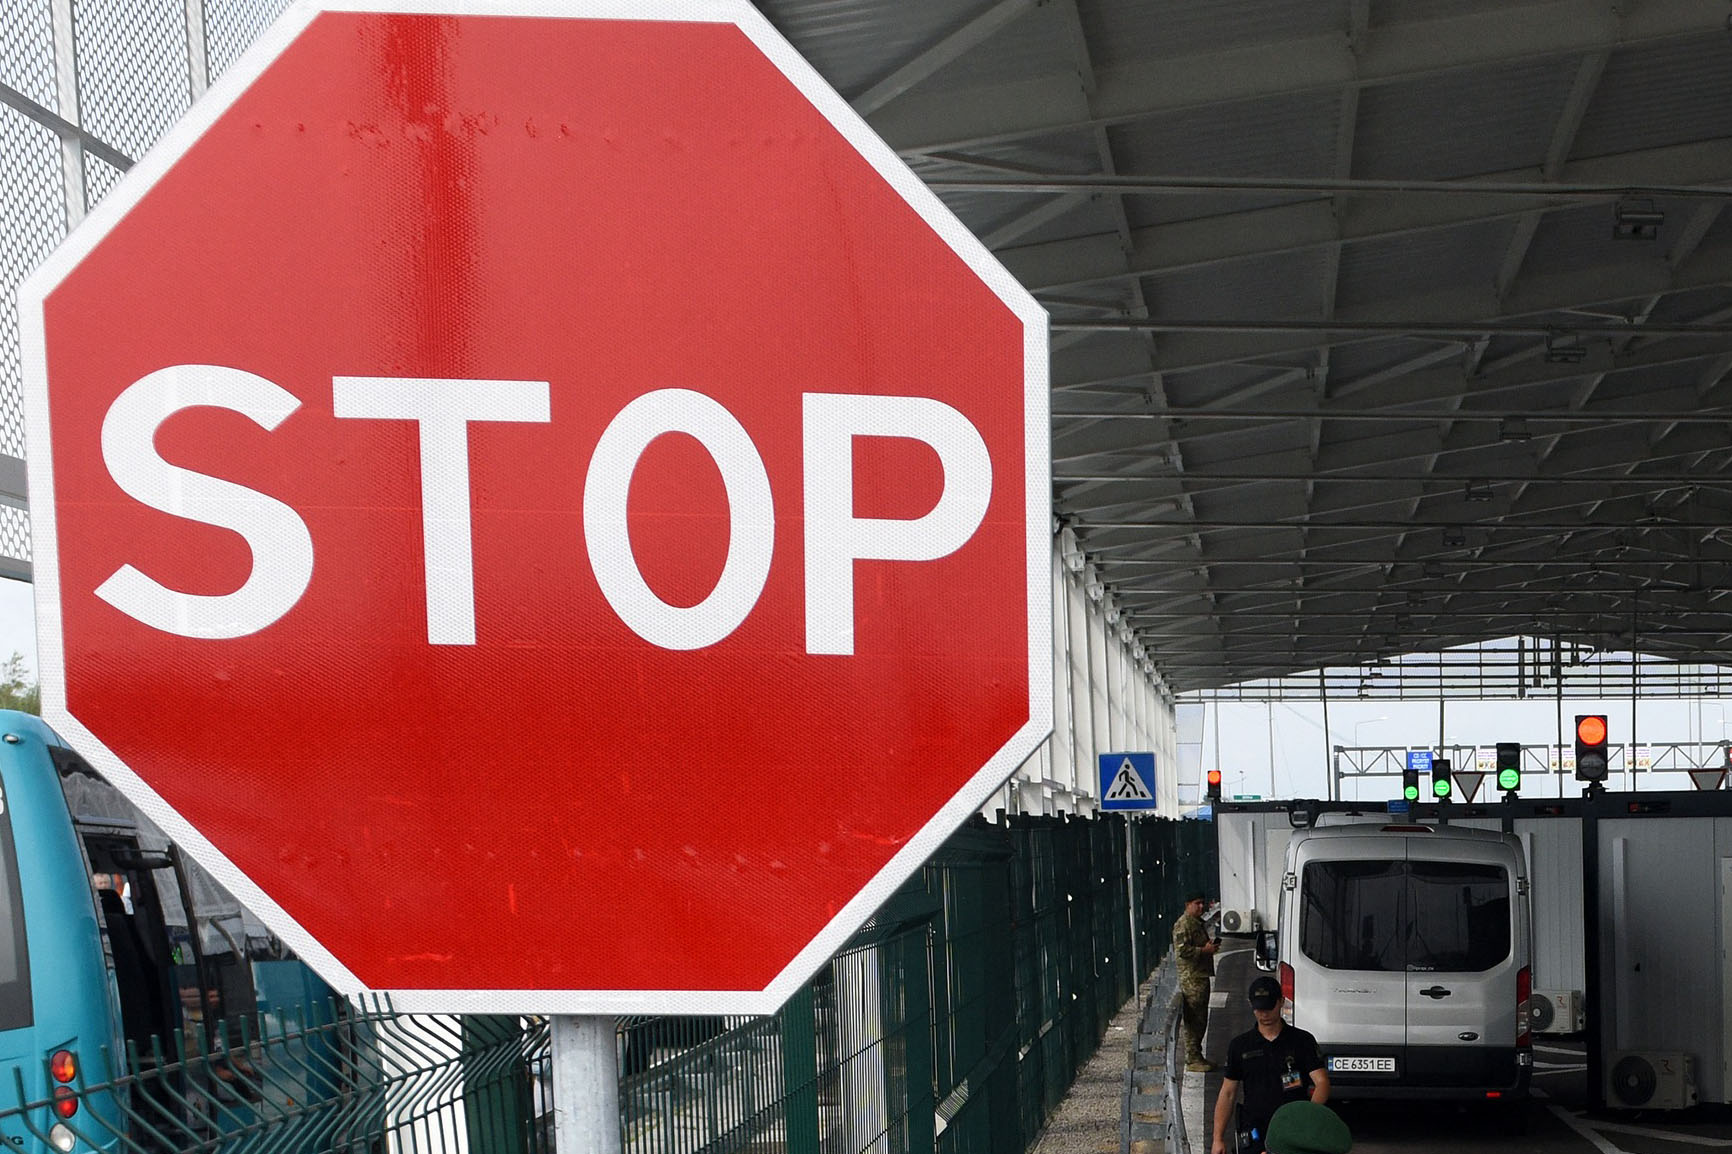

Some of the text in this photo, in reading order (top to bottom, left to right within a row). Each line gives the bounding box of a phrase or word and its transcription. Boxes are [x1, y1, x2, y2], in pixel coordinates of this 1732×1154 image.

[93, 364, 993, 655] STOP
[1334, 1059, 1392, 1070] CE 6351 EE
